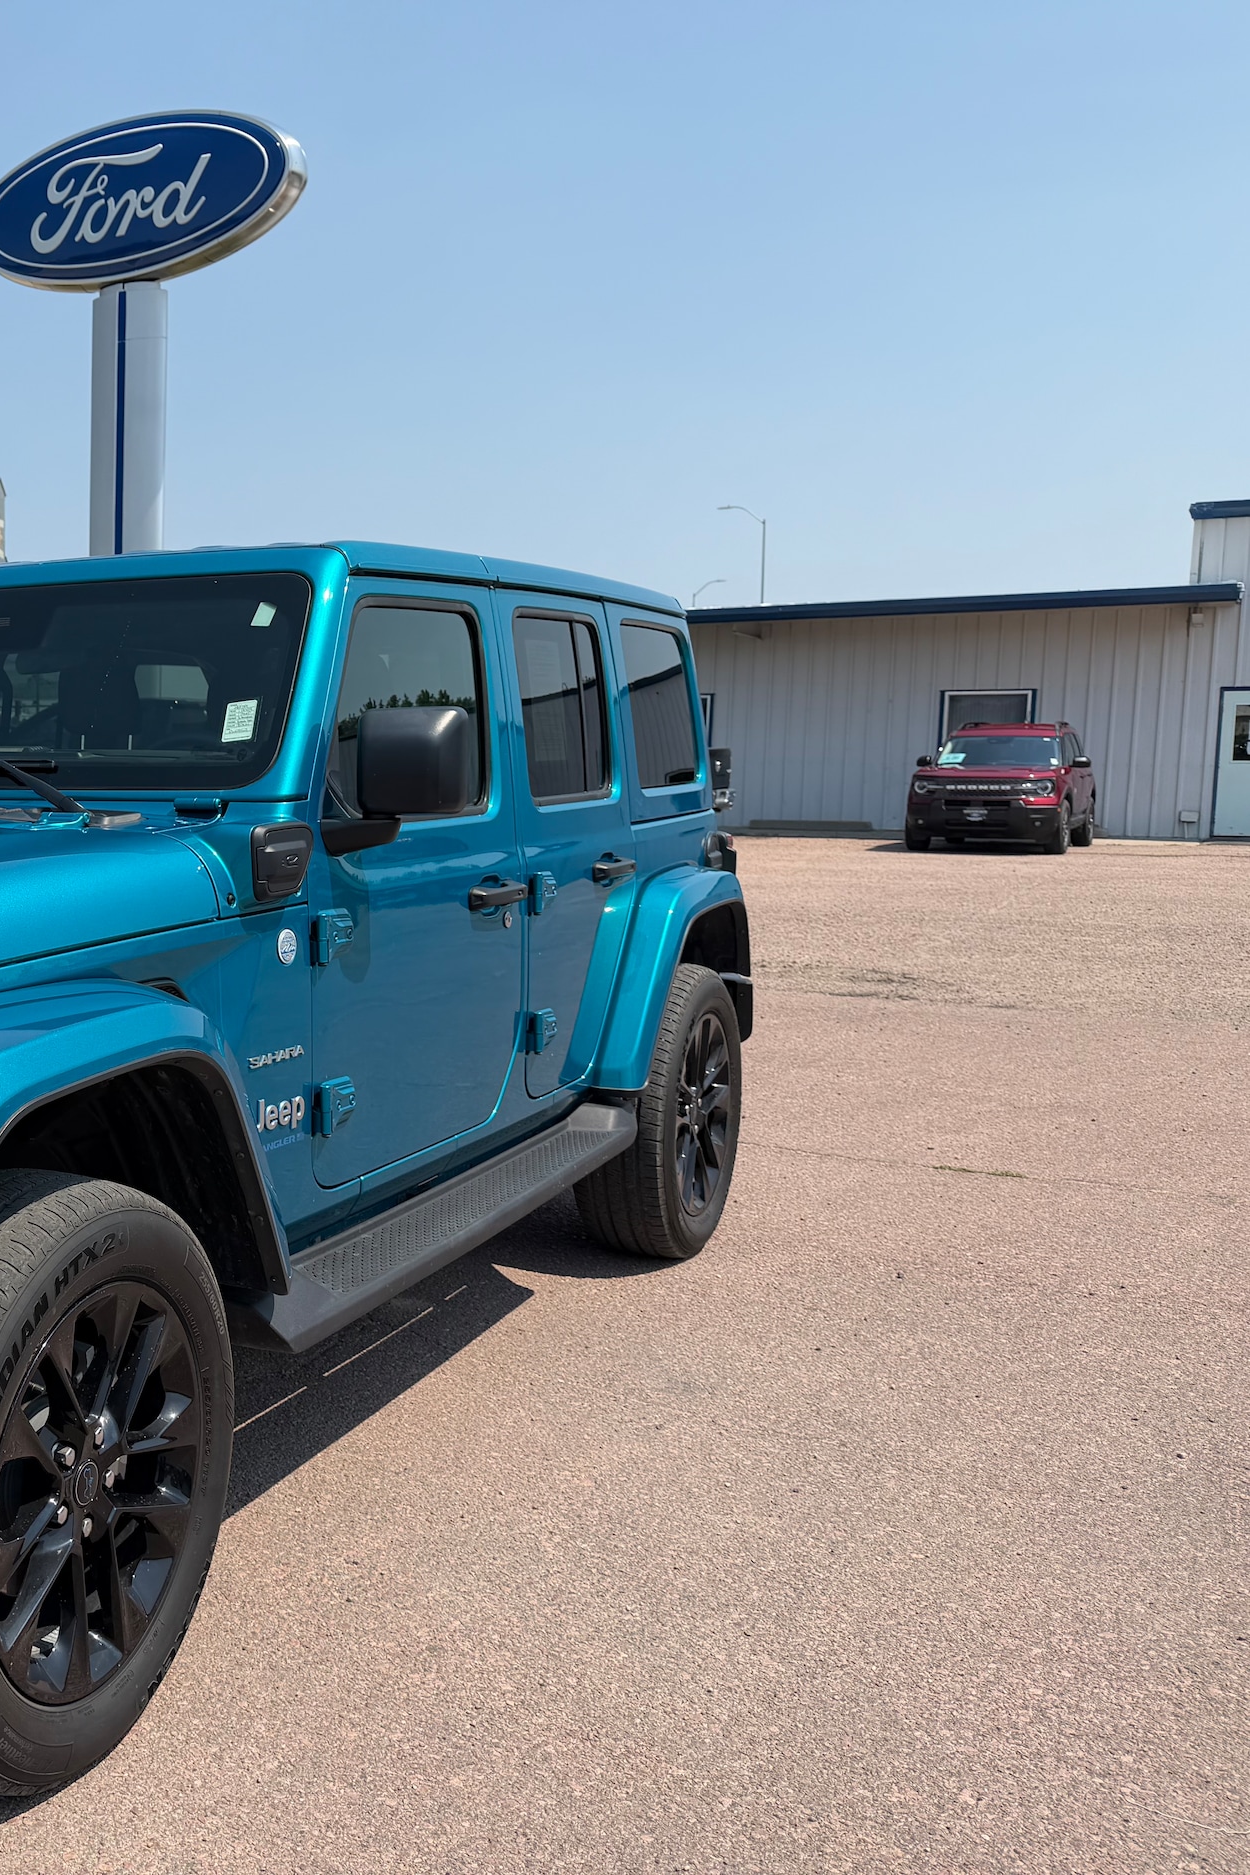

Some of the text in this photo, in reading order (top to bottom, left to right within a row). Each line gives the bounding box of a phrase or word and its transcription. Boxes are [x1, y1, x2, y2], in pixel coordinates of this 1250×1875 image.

[29, 143, 212, 254] Ford
[247, 1045, 305, 1069] SAHARA
[256, 1095, 305, 1133] Jeep
[262, 1135, 296, 1151] NGLER
[53, 1231, 117, 1297] HTX2
